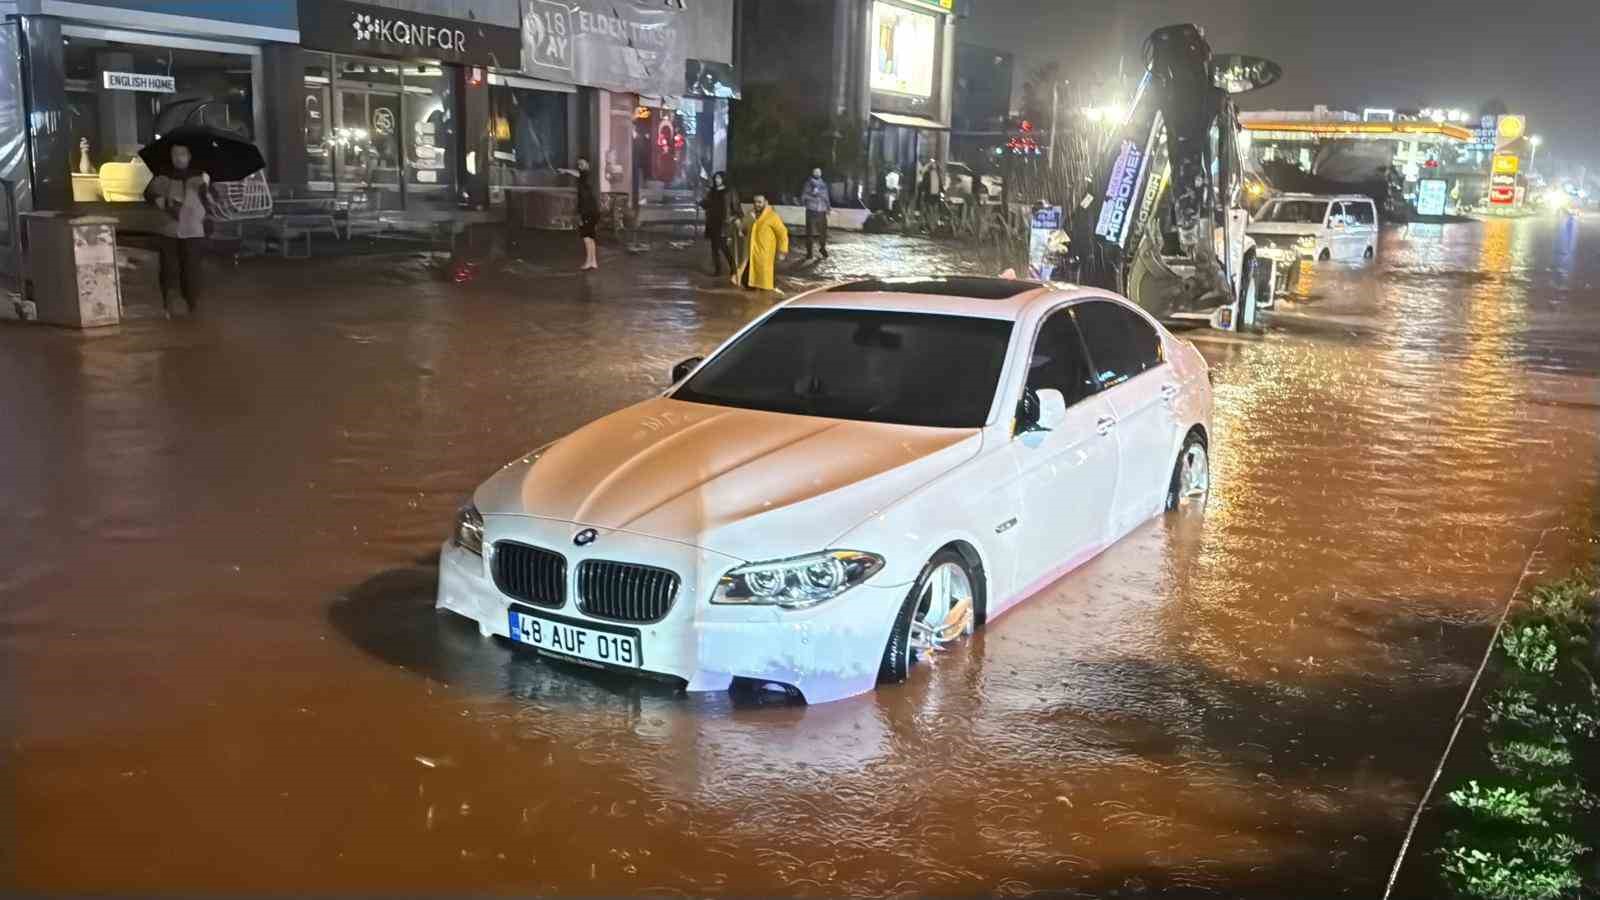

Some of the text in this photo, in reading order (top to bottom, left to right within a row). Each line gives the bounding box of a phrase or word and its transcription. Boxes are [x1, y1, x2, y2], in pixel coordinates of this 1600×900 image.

[545, 13, 566, 36] 18
[580, 13, 629, 41] ELDEN
[546, 37, 568, 60] AY
[109, 75, 174, 91] ENGLISH HOME
[521, 617, 542, 643] 48
[552, 625, 587, 653] AUF
[597, 635, 633, 663] 019
